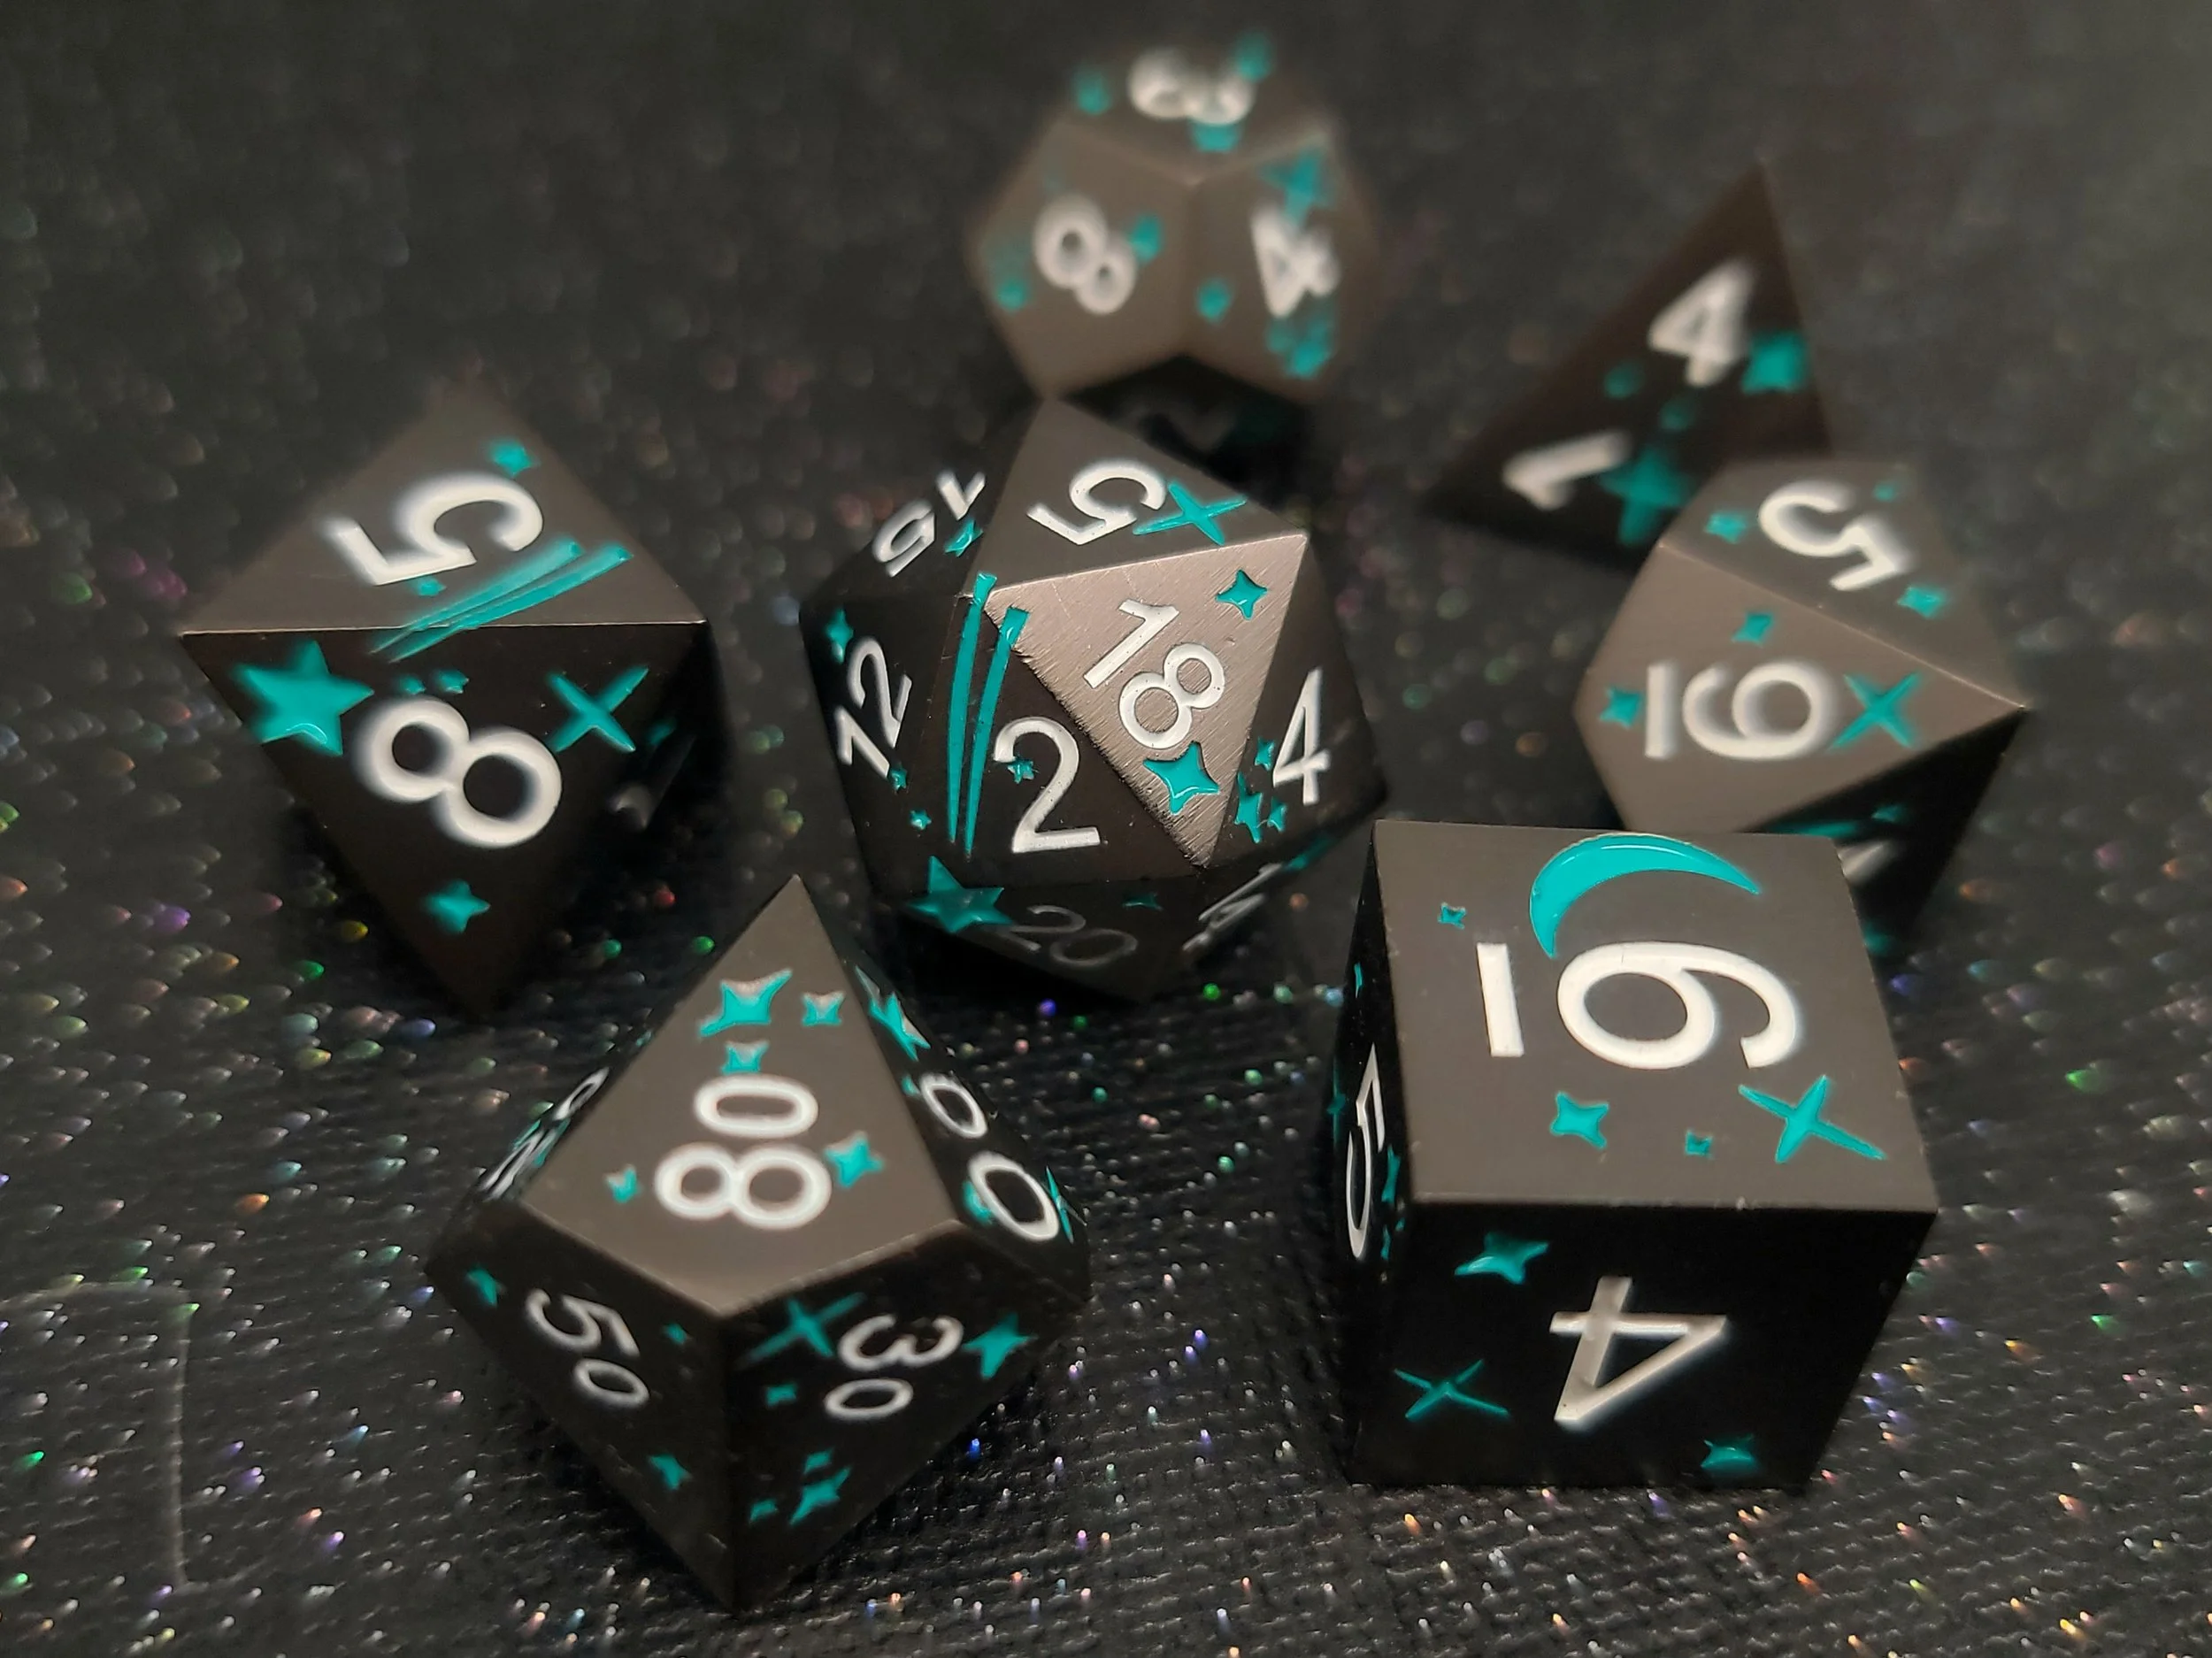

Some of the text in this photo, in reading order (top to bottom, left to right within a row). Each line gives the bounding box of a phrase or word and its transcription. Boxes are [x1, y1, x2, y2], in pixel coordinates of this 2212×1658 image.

[1033, 194, 1138, 315] 8
[1646, 258, 1756, 387] 4
[323, 471, 544, 586] 5
[872, 469, 987, 577] 15
[1026, 459, 1166, 545] 5
[1503, 431, 1633, 510] 1
[1758, 478, 1913, 590] 5
[835, 637, 914, 779] 12
[1083, 598, 1226, 750] 18
[1271, 668, 1333, 806] 4
[356, 695, 563, 848] 8
[993, 715, 1102, 854] 2
[653, 1072, 834, 1230] 80
[919, 1071, 1061, 1240] 00
[1346, 1042, 1386, 1261] 5
[524, 1287, 650, 1409] 50
[823, 1314, 965, 1421] 30
[1550, 1275, 1732, 1432] 4
